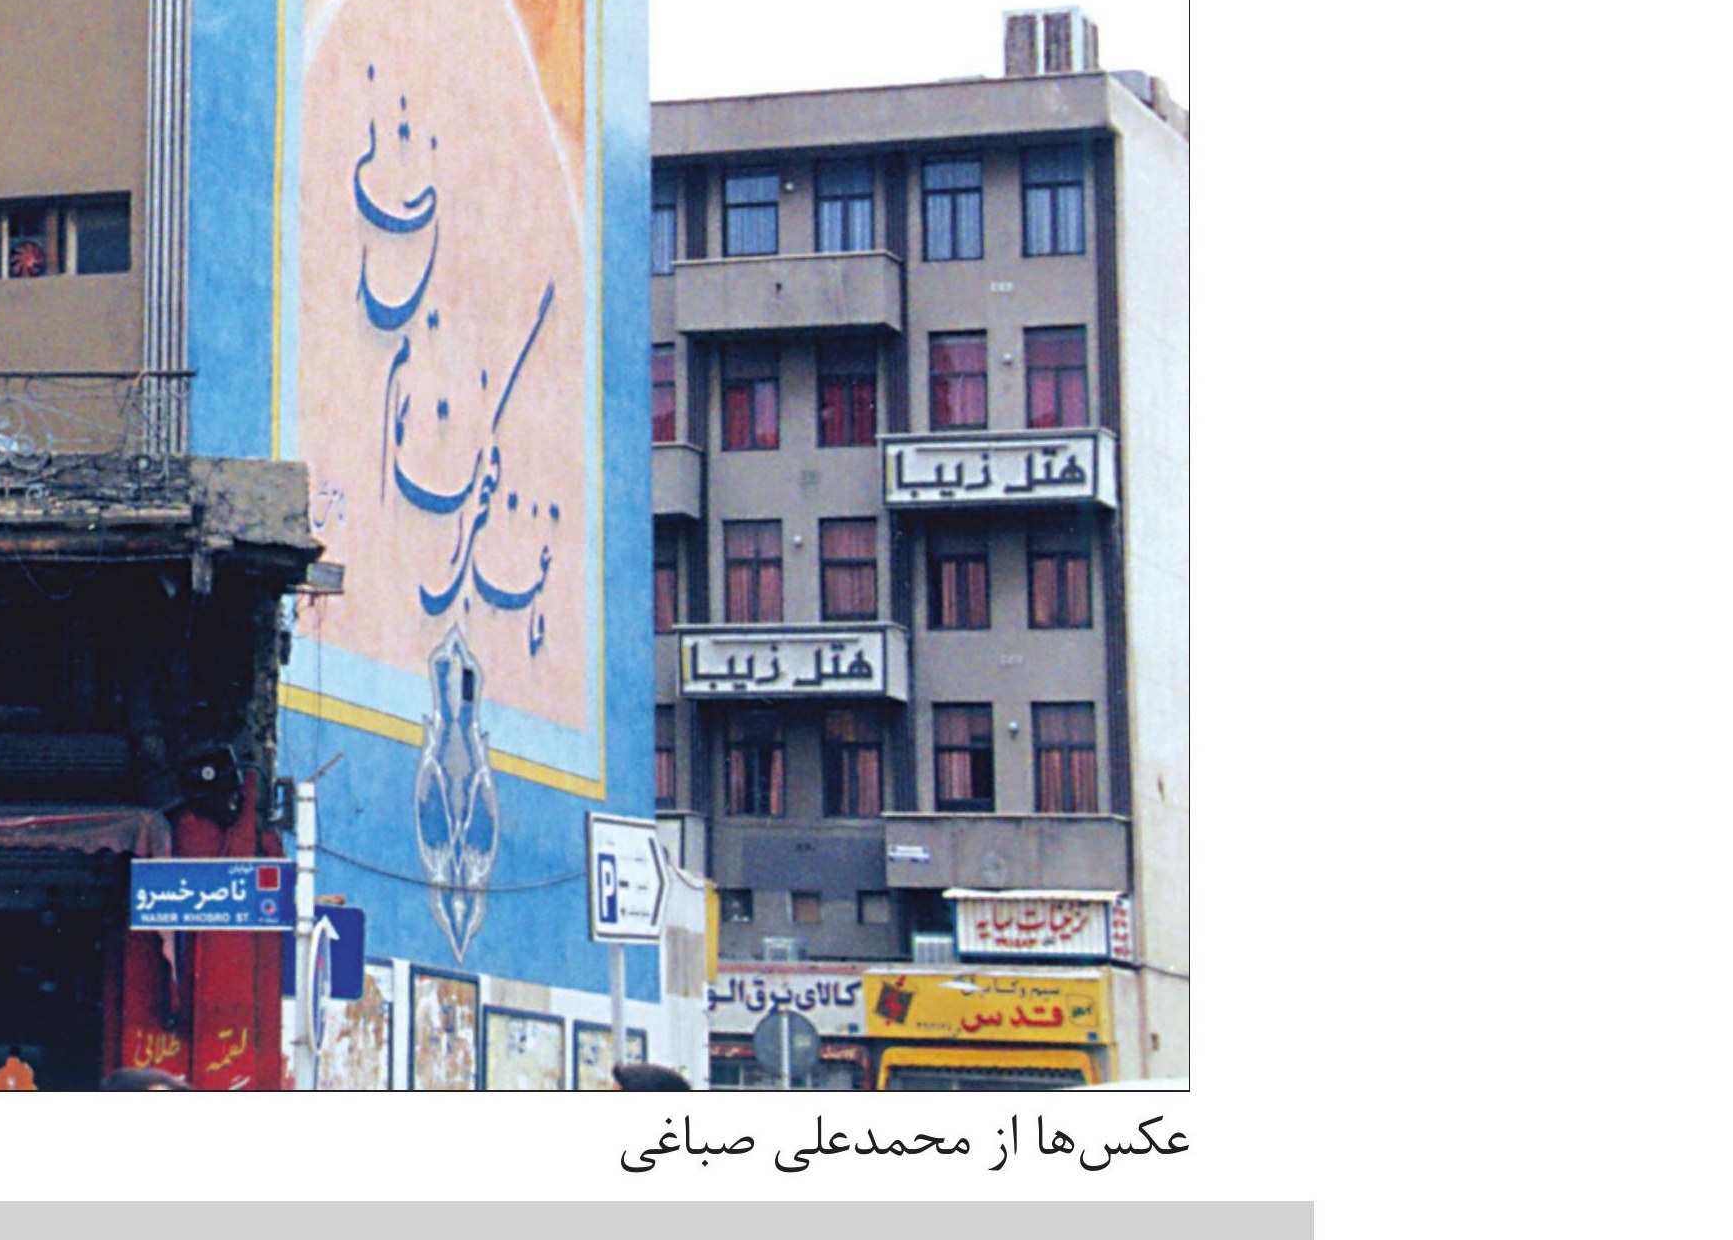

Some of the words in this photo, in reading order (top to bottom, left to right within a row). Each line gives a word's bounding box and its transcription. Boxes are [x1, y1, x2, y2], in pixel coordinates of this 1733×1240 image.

[895, 450, 992, 498] زیبا
[1004, 447, 1088, 495] هتل
[690, 643, 781, 692] زیبا
[793, 643, 874, 688] هتل
[135, 879, 195, 910] خسرو
[193, 879, 247, 910] ناصر
[140, 913, 179, 924] NASER
[183, 913, 230, 924] KHOSRO
[235, 912, 250, 924] ST
[745, 976, 793, 1015] برق
[795, 971, 862, 1011] کالای
[960, 1004, 1065, 1033] قدس
